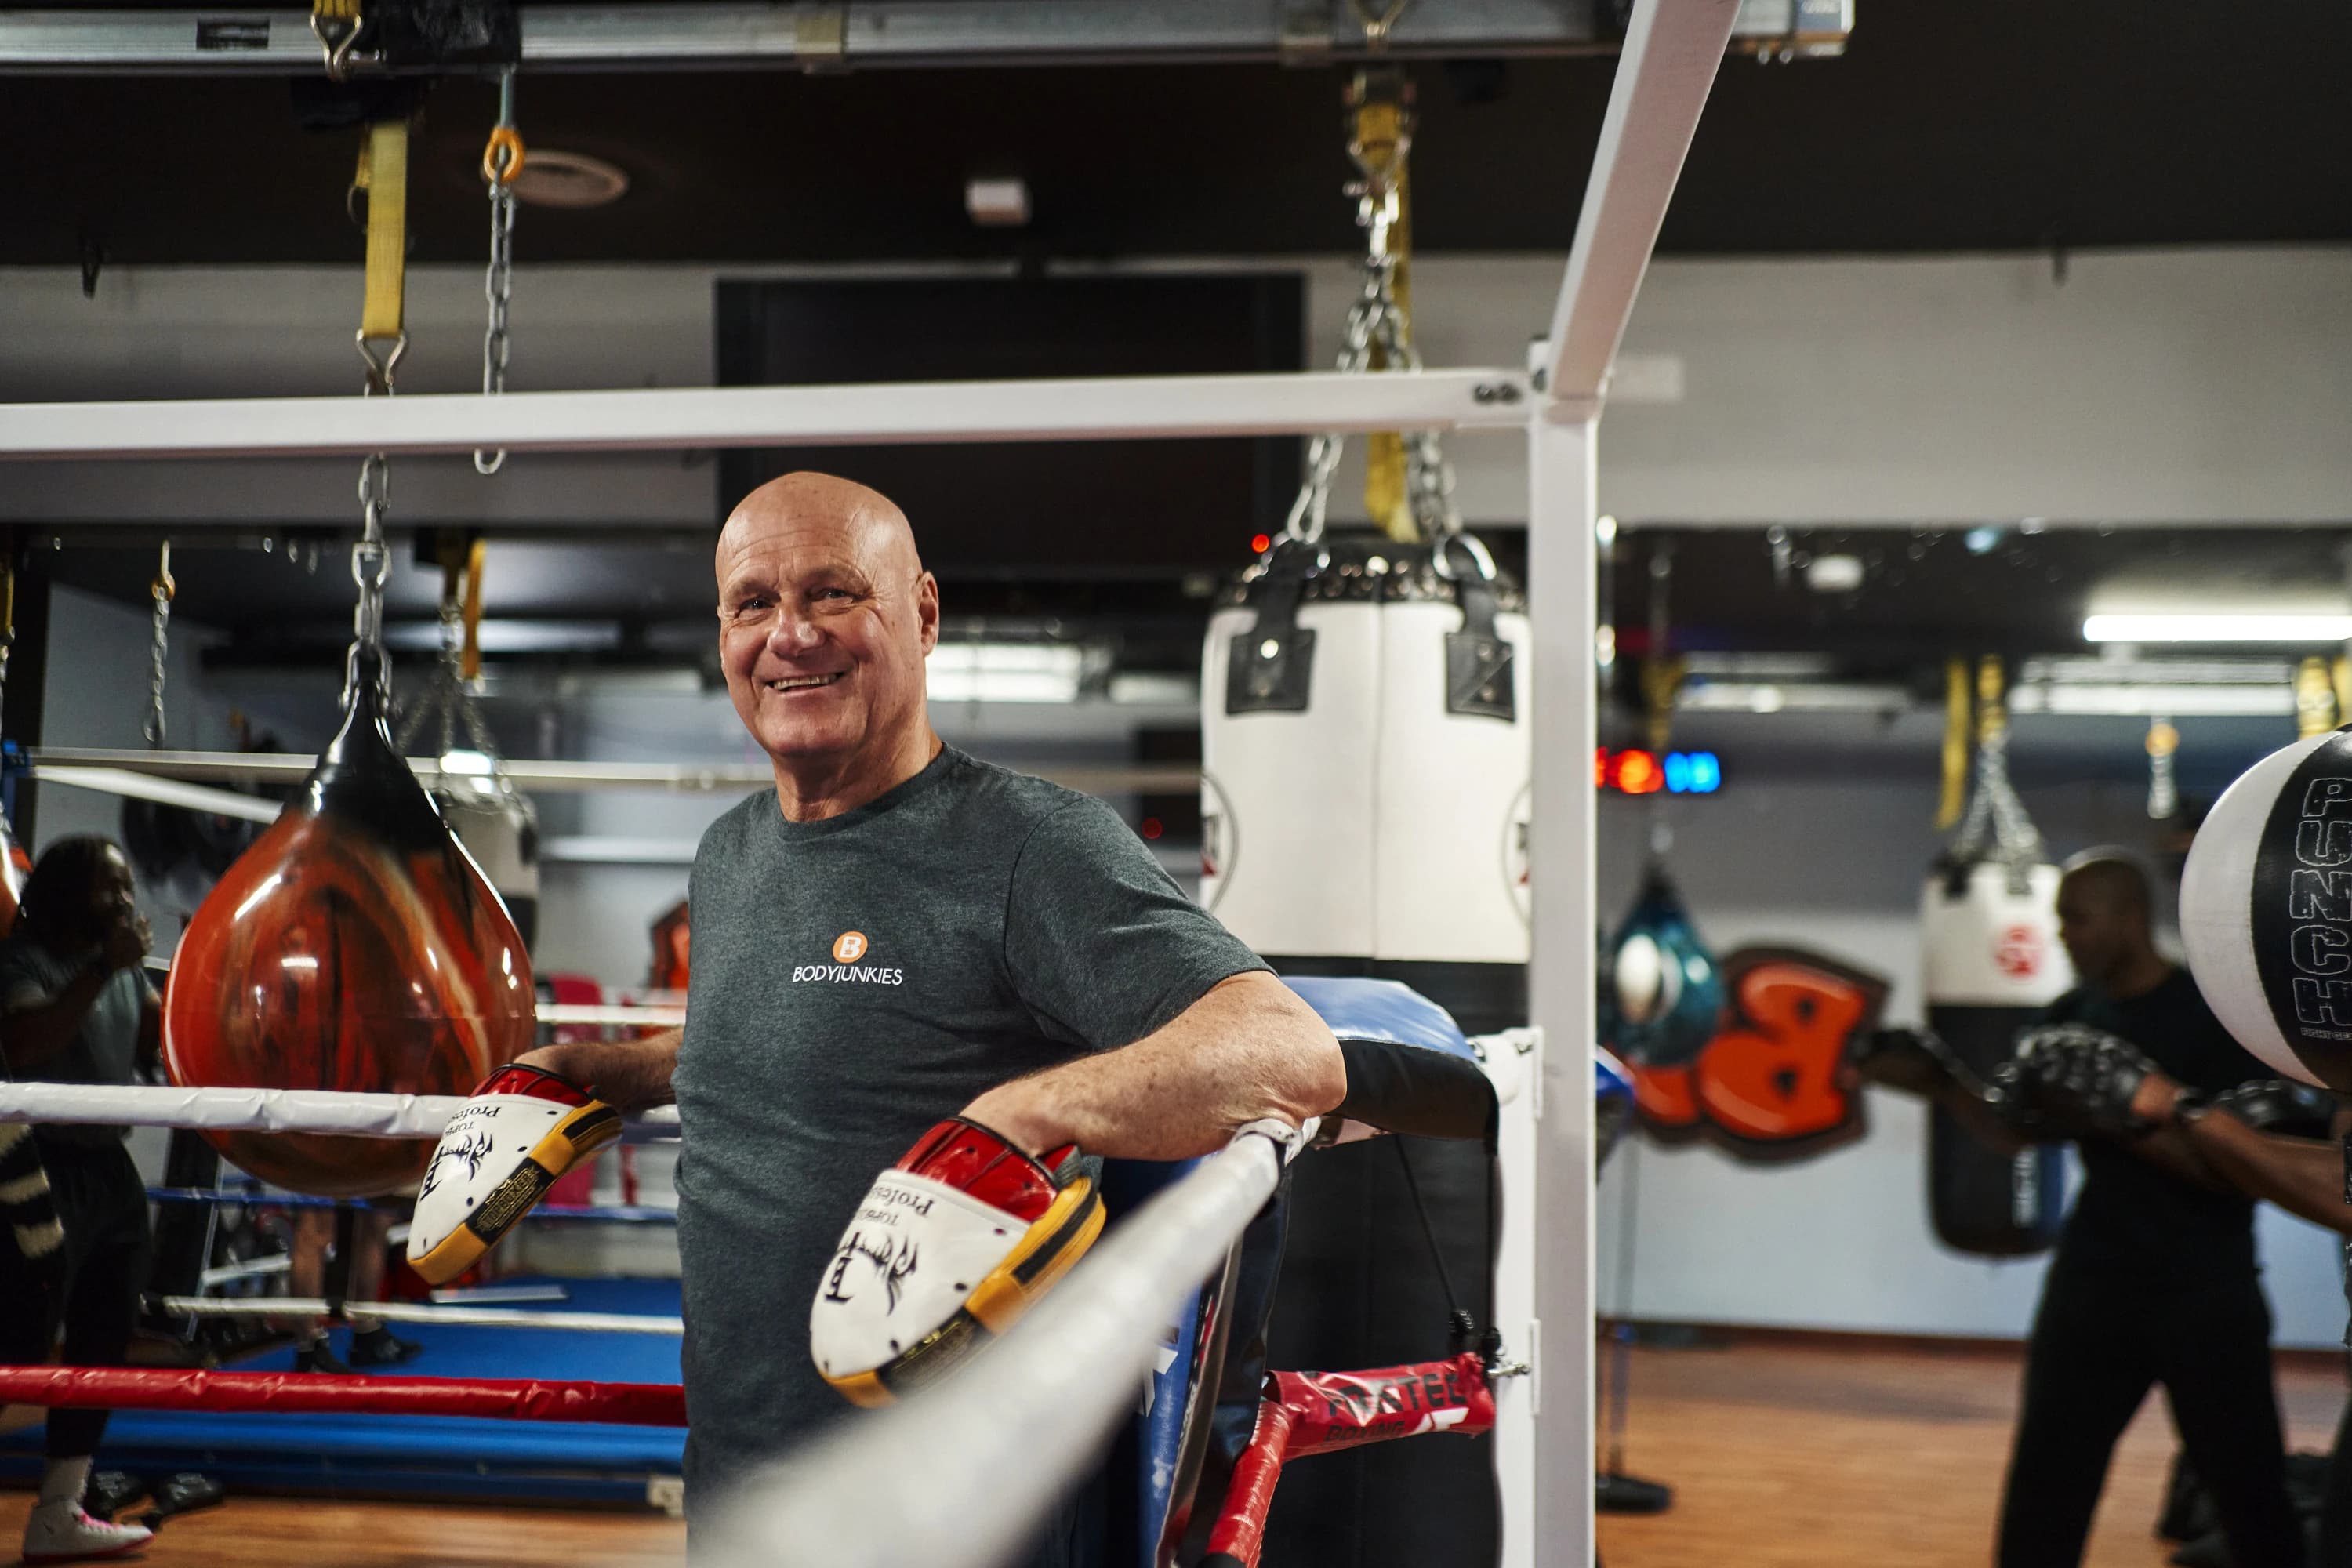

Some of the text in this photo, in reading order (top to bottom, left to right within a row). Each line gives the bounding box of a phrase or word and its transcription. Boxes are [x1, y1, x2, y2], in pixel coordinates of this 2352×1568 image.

[2289, 777, 2352, 1027] PUNCH
[839, 935, 862, 958] B
[792, 965, 903, 985] BODYJUNKIES
[483, 1173, 535, 1227] TOPBOXER
